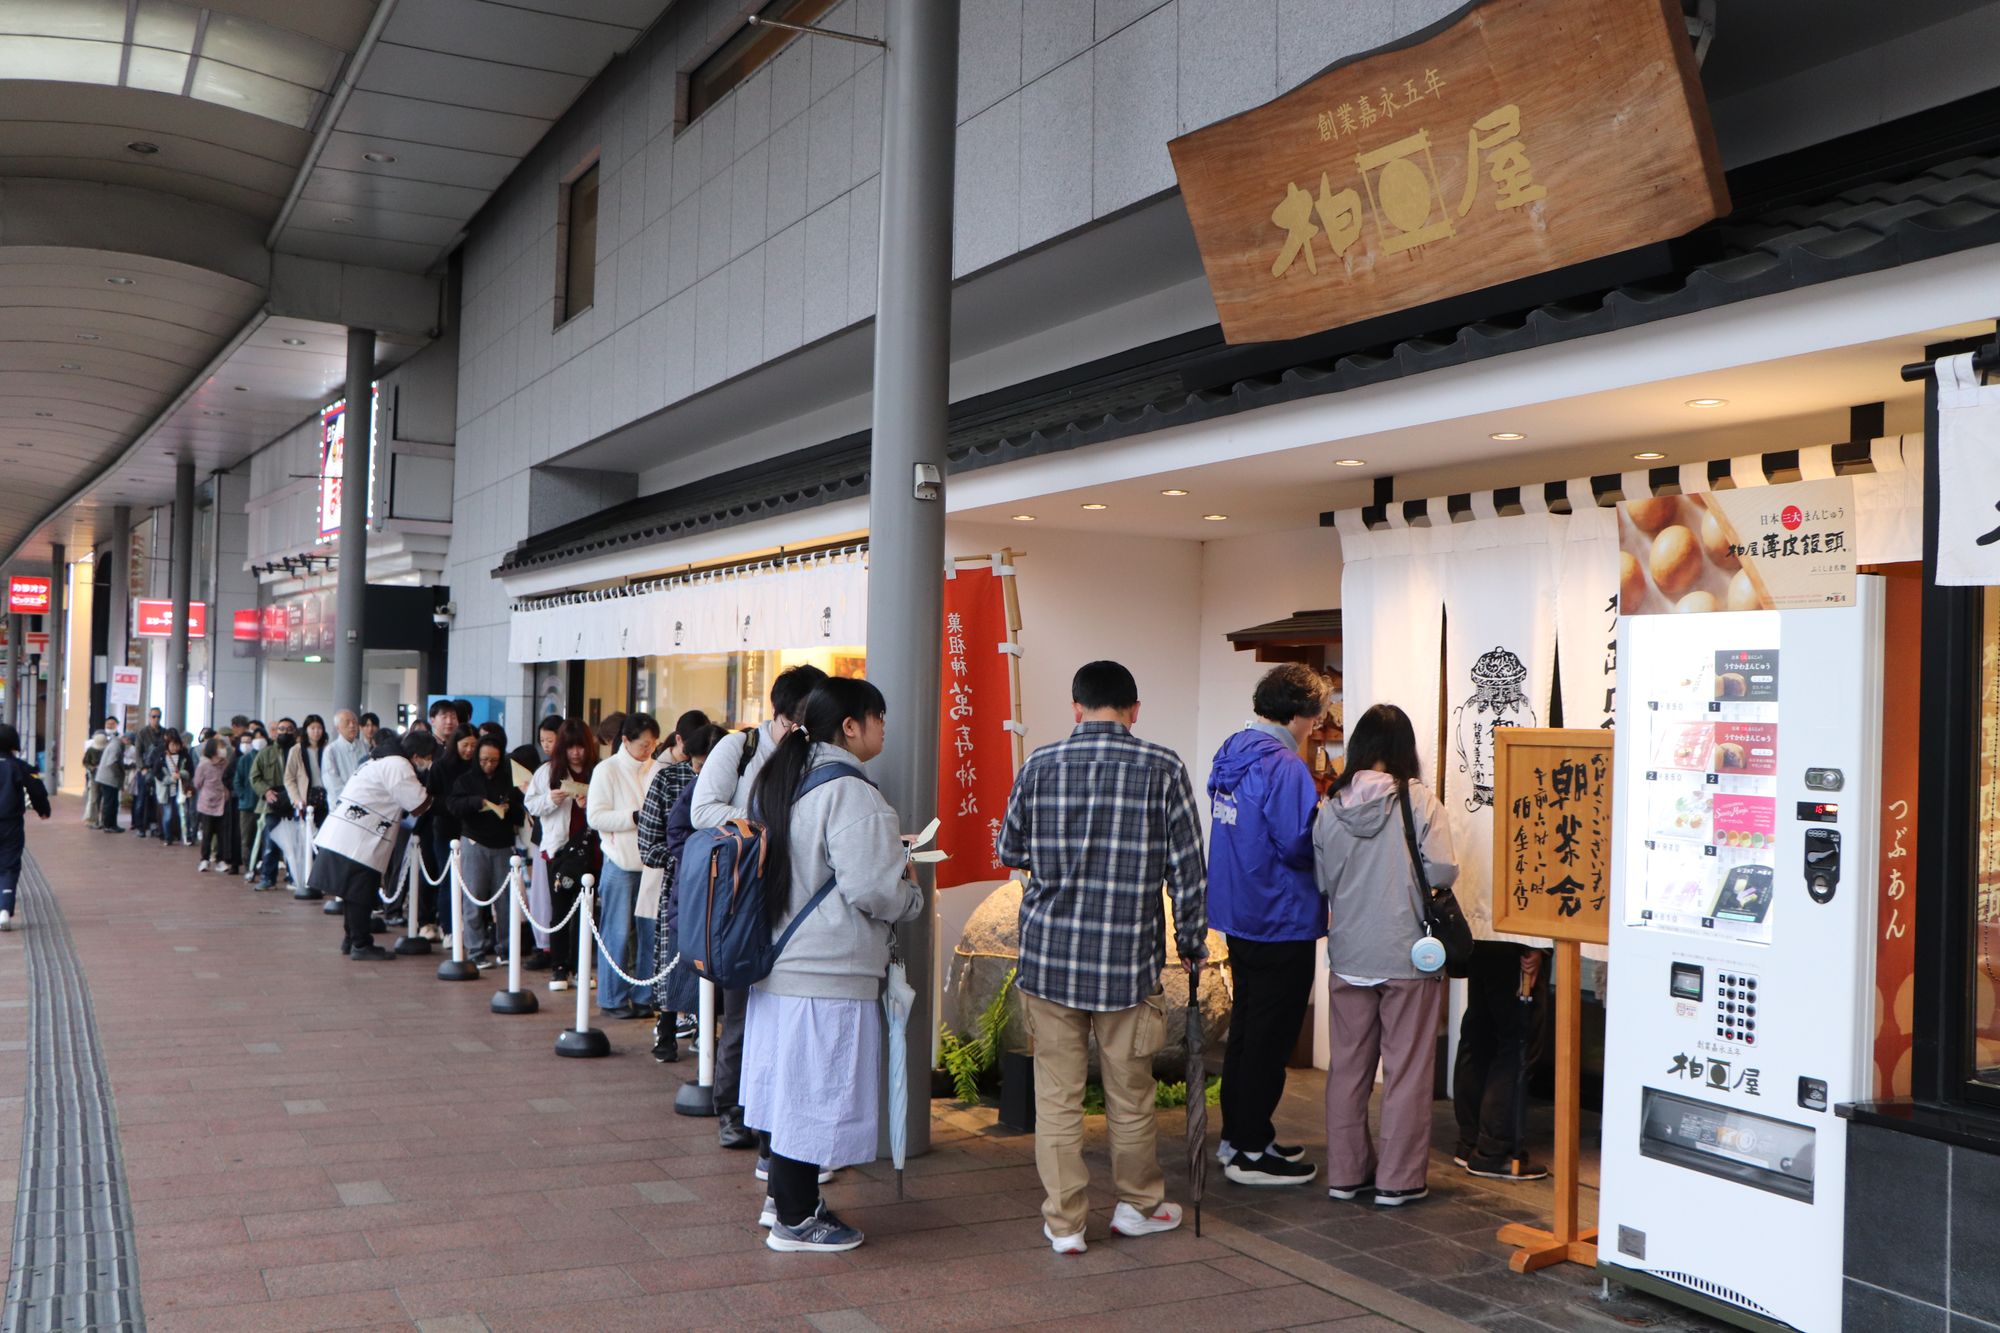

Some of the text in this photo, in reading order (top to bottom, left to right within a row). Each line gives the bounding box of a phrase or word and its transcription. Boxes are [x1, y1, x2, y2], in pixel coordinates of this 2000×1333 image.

[1317, 67, 1446, 143] 創業嘉永五年
[1271, 104, 1548, 279] 柏屋
[1760, 507, 1845, 526] 日本三大まんじゅう
[1726, 531, 1847, 559] 柏屋薄皮饅頭
[1724, 663, 1771, 671] うすかわまんじゅう
[1724, 734, 1772, 742] うすかわまんじゅう
[1590, 753, 1610, 911] おはようございます
[1886, 799, 1908, 940] つぶあん
[1667, 1052, 1761, 1096] 柏屋
